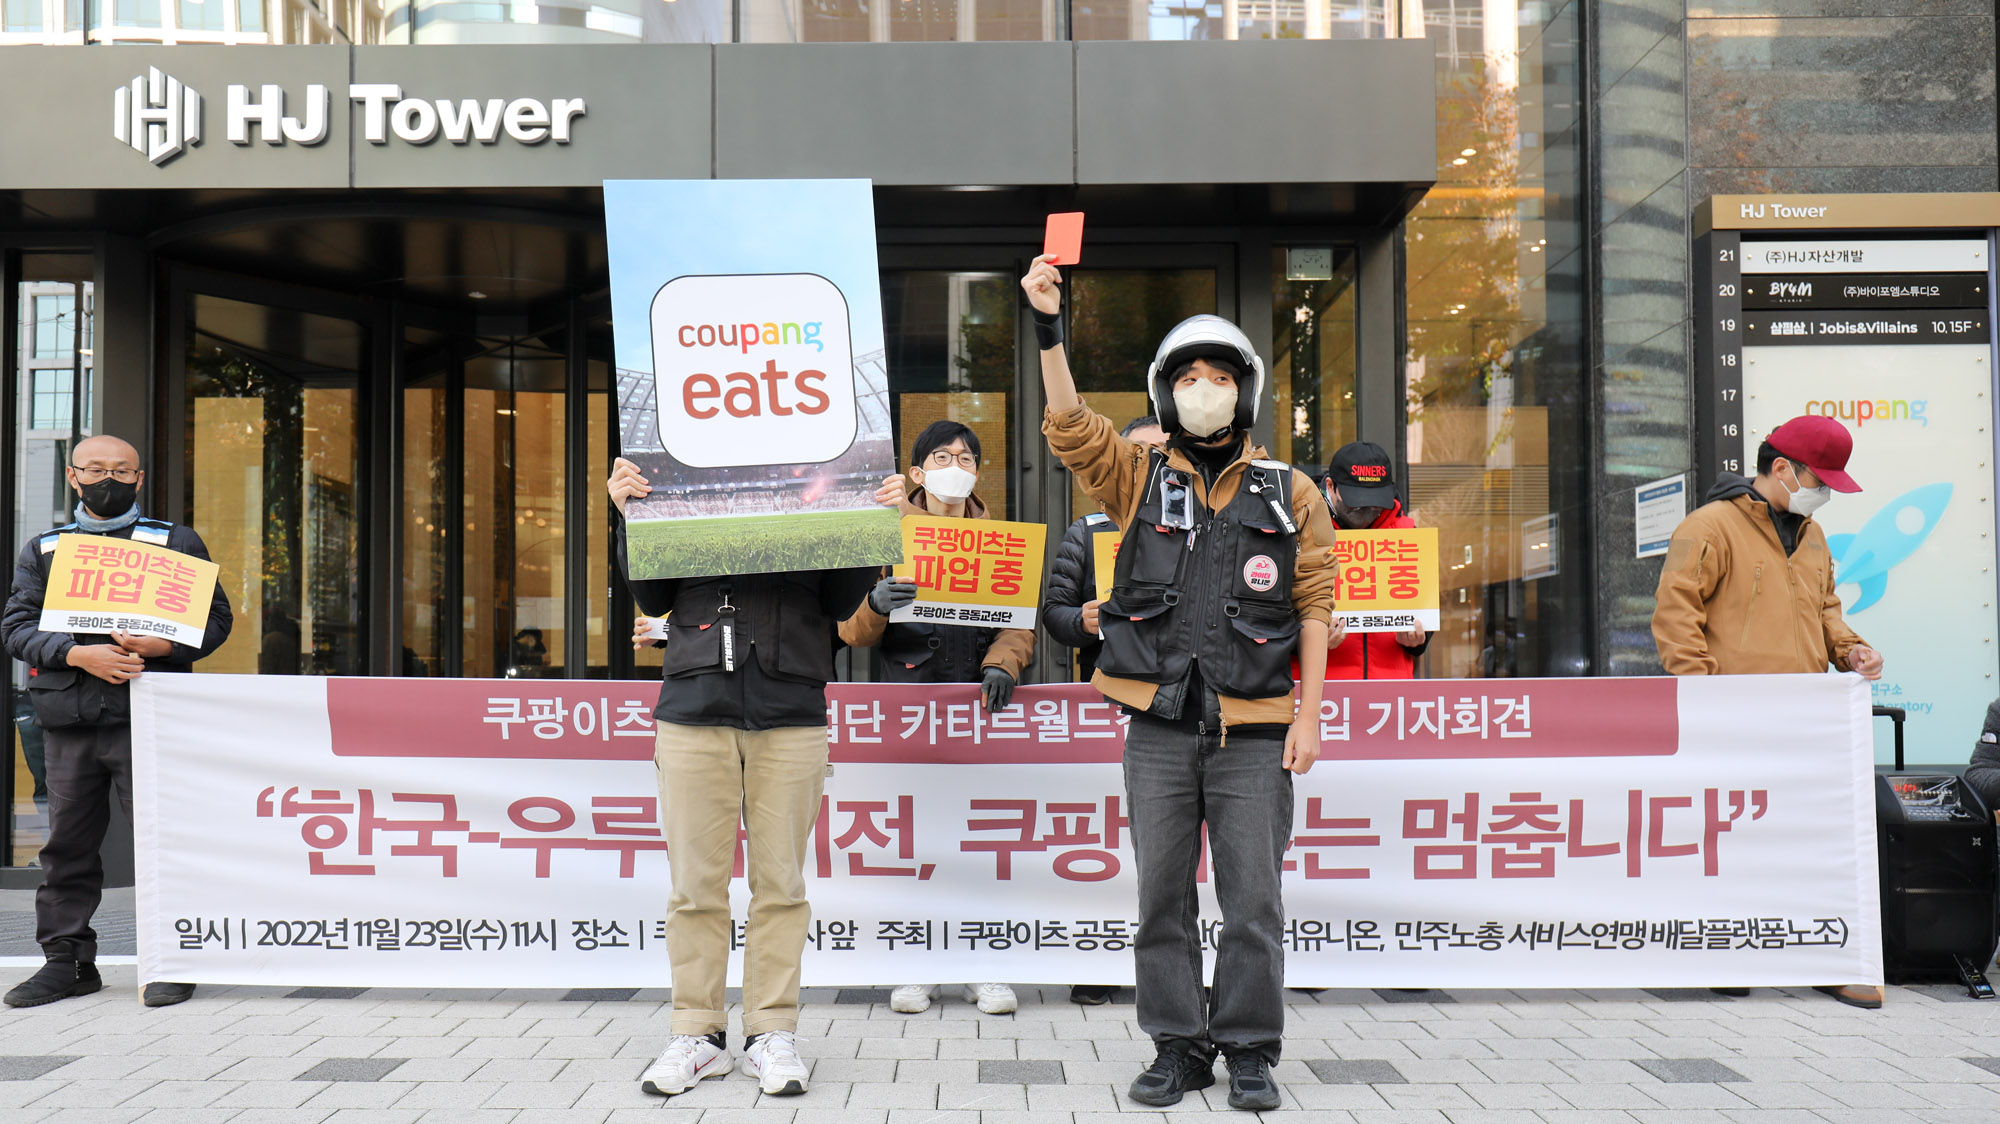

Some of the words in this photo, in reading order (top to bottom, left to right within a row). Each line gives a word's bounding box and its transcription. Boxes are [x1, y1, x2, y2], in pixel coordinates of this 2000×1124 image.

[226, 84, 330, 145] HJ
[350, 83, 587, 144] Tower
[1740, 204, 1765, 219] HJ
[1771, 203, 1827, 218] Tower
[1719, 250, 1735, 262] 21
[1719, 285, 1736, 296] 20
[1720, 320, 1736, 332] 19
[1819, 321, 1918, 335] Jobis&Villains
[678, 322, 824, 354] coupang
[1720, 355, 1736, 366] 18
[682, 359, 830, 419] eats
[1721, 390, 1737, 401] 17
[1805, 400, 1928, 427] coupang
[1722, 424, 1738, 436] 16
[1351, 465, 1387, 477] SINNERS
[1723, 459, 1738, 471] 15
[913, 526, 1026, 557] 쿠팡이츠는
[1329, 539, 1419, 563] 팡이츠는
[74, 543, 197, 584] 쿠팡이츠는
[912, 555, 981, 593] 파업
[990, 560, 1023, 595] 중
[1387, 565, 1420, 599] 중
[66, 568, 146, 604] 파업
[155, 579, 191, 614] 중
[912, 606, 956, 619] 쿠팡이츠
[958, 608, 1013, 623] 공동교섭단
[1362, 615, 1415, 628] 공동교섭단
[67, 616, 114, 628] 쿠팡이츠
[116, 617, 178, 636] 공동교섭단
[483, 697, 656, 741] 쿠팡이츠
[1366, 694, 1532, 740] 기자회견
[960, 795, 1380, 882] 쿠팡는
[175, 917, 230, 950] 일시
[257, 918, 349, 950] 2022년
[353, 918, 401, 950] 11월
[405, 918, 507, 951] 23일(수)
[510, 918, 558, 951] 11시
[571, 919, 629, 951] 장소
[876, 919, 932, 951] 주최
[958, 920, 1070, 951] 쿠팡이츠
[1394, 921, 1505, 951] 민주노총
[1507, 920, 1647, 950] 서비스연맹
[1650, 917, 1849, 950] 배달플랫폼노조)
